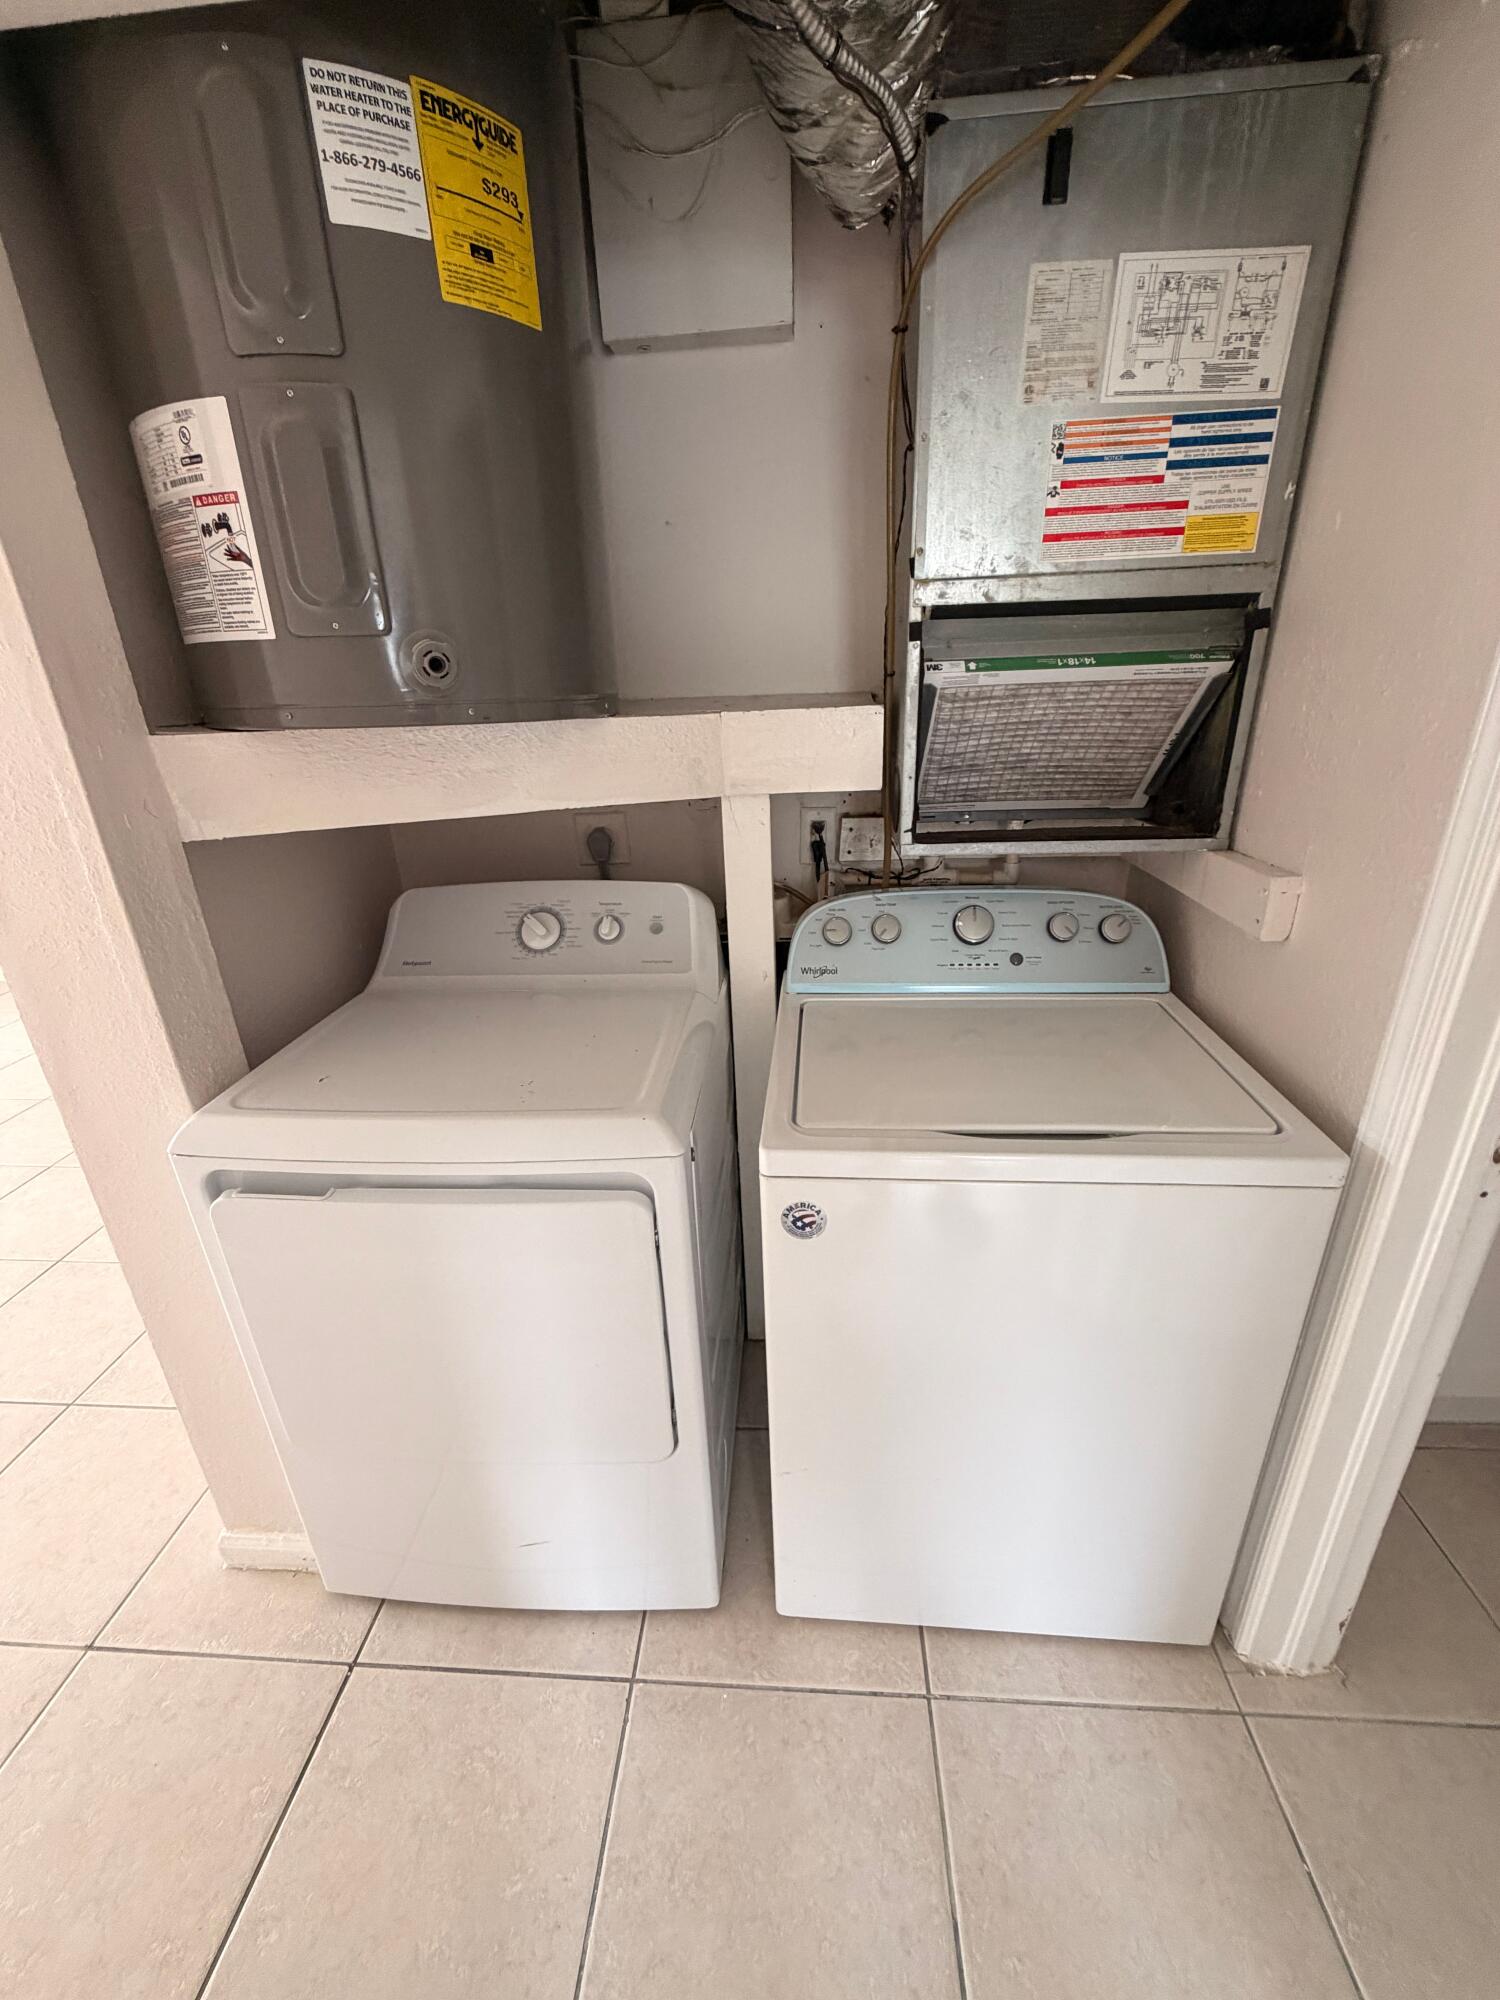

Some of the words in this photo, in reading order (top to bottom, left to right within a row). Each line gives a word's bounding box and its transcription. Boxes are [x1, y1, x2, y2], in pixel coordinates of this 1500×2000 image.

[309, 66, 326, 79] DO
[327, 70, 347, 84] NOT
[348, 74, 387, 94] RETURN
[387, 84, 408, 100] THIS
[310, 82, 343, 99] WATER
[344, 90, 381, 108] HEATER
[381, 97, 394, 110] TO
[393, 101, 412, 117] THE
[316, 101, 347, 116] PLACE
[347, 105, 361, 118] OF
[363, 110, 412, 132] PURCHASE
[320, 148, 422, 183] 1-866-279-4566
[202, 493, 236, 506] DANGER
[926, 663, 943, 672] 3M
[1057, 656, 1097, 666] 14x18x1
[800, 966, 838, 978] Whirlpool
[783, 1202, 822, 1219] AMERICA
